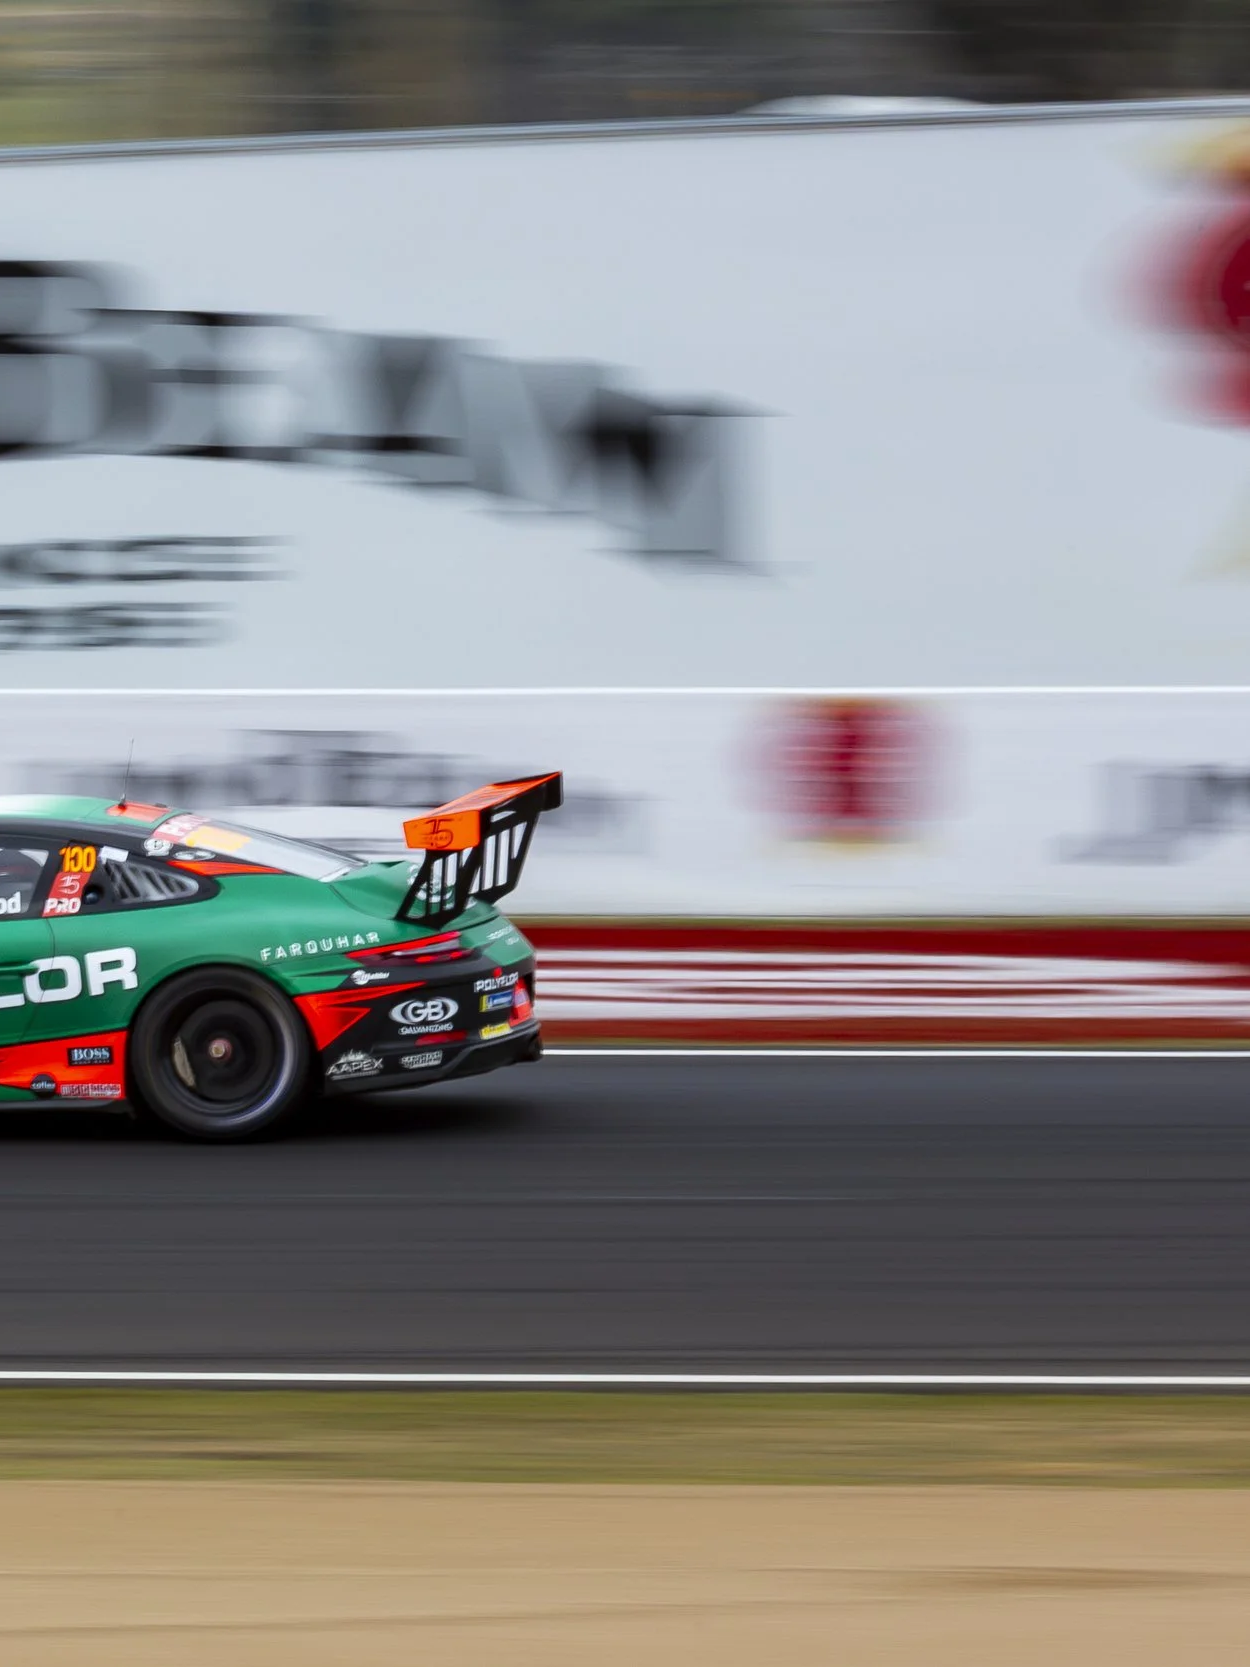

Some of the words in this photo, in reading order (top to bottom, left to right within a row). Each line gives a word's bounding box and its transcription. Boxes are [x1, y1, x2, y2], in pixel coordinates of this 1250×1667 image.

[58, 845, 97, 873] 100
[44, 897, 82, 914] PRO
[260, 931, 381, 962] FARQUHAR
[406, 1000, 445, 1023] GB
[71, 1047, 111, 1061] BOSS
